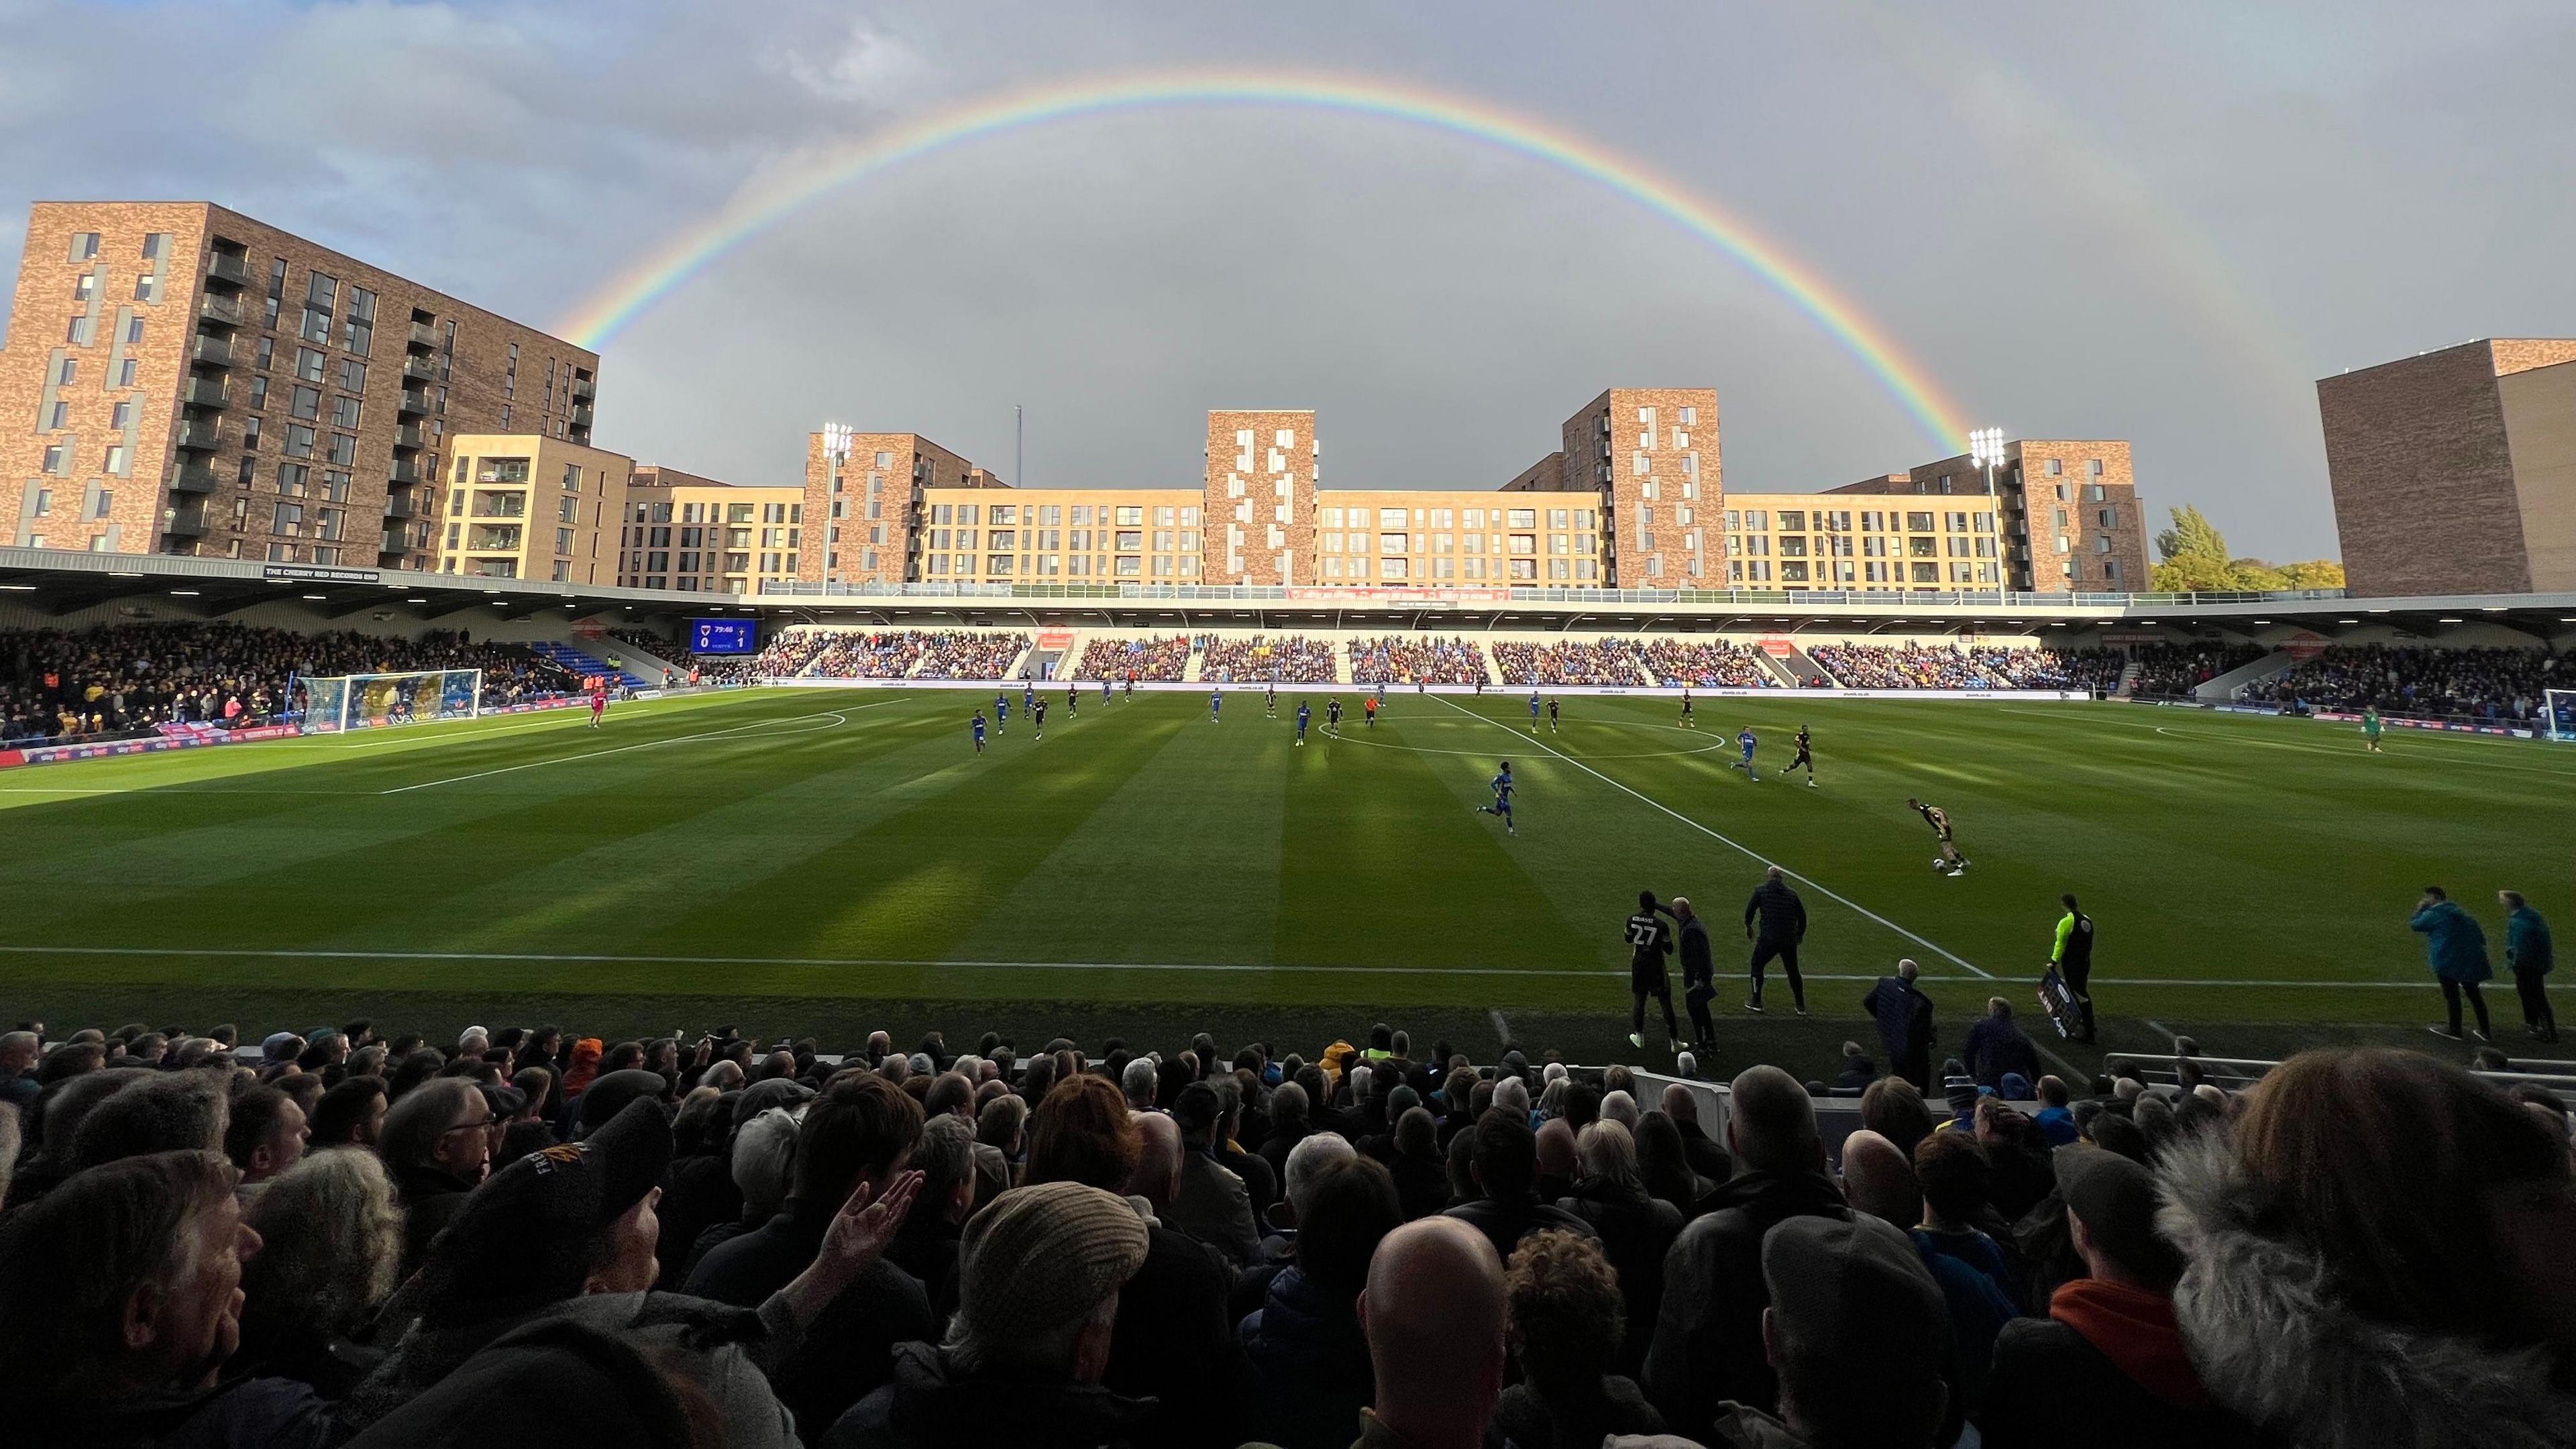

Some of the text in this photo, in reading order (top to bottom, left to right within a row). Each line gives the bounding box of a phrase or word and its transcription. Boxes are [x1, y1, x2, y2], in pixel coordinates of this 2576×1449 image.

[283, 569, 314, 577] CHERRY
[330, 572, 363, 580] RECORDS
[700, 637, 709, 648] 0
[737, 637, 744, 647] 1
[1631, 924, 1658, 946] 27
